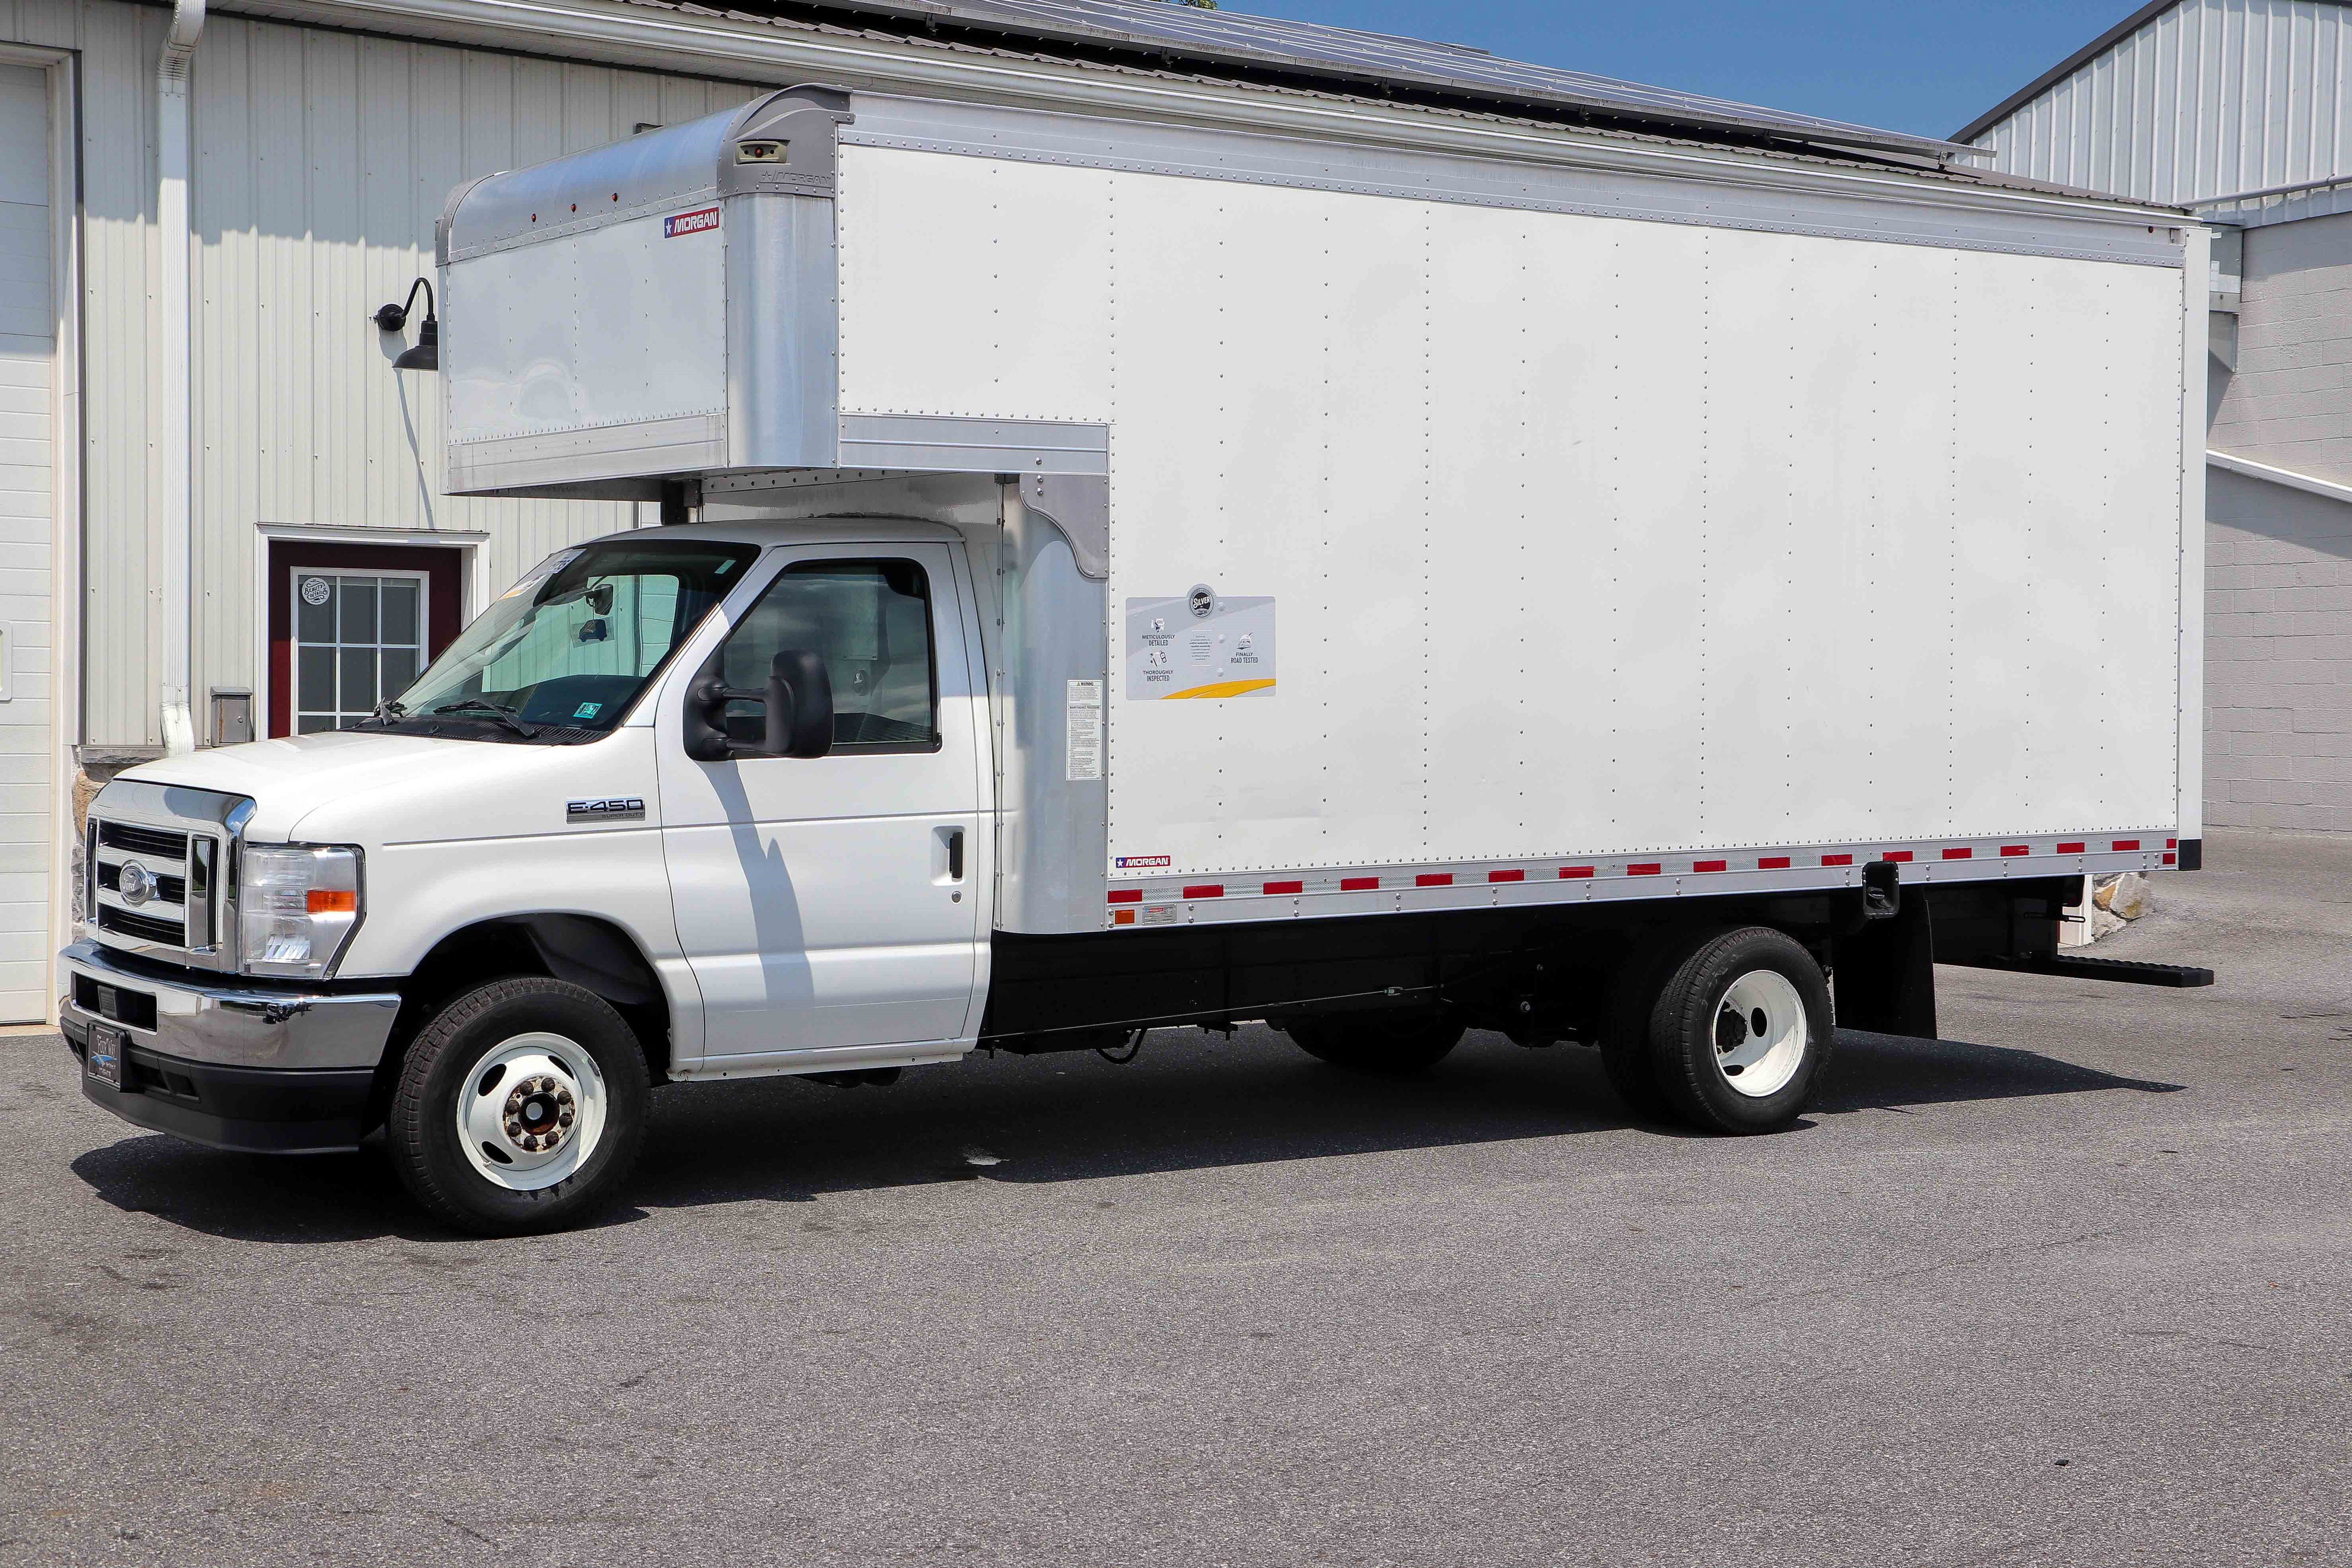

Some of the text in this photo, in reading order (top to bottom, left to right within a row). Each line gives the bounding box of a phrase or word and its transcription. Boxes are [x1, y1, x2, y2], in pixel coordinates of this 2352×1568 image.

[776, 172, 827, 184] MORGAN
[674, 211, 717, 233] MORGAN
[304, 584, 323, 595] BEAUTY
[1193, 596, 1210, 608] SILVER
[568, 799, 644, 814] E-450
[1126, 858, 1168, 866] MORGAN
[122, 873, 136, 891] Ford
